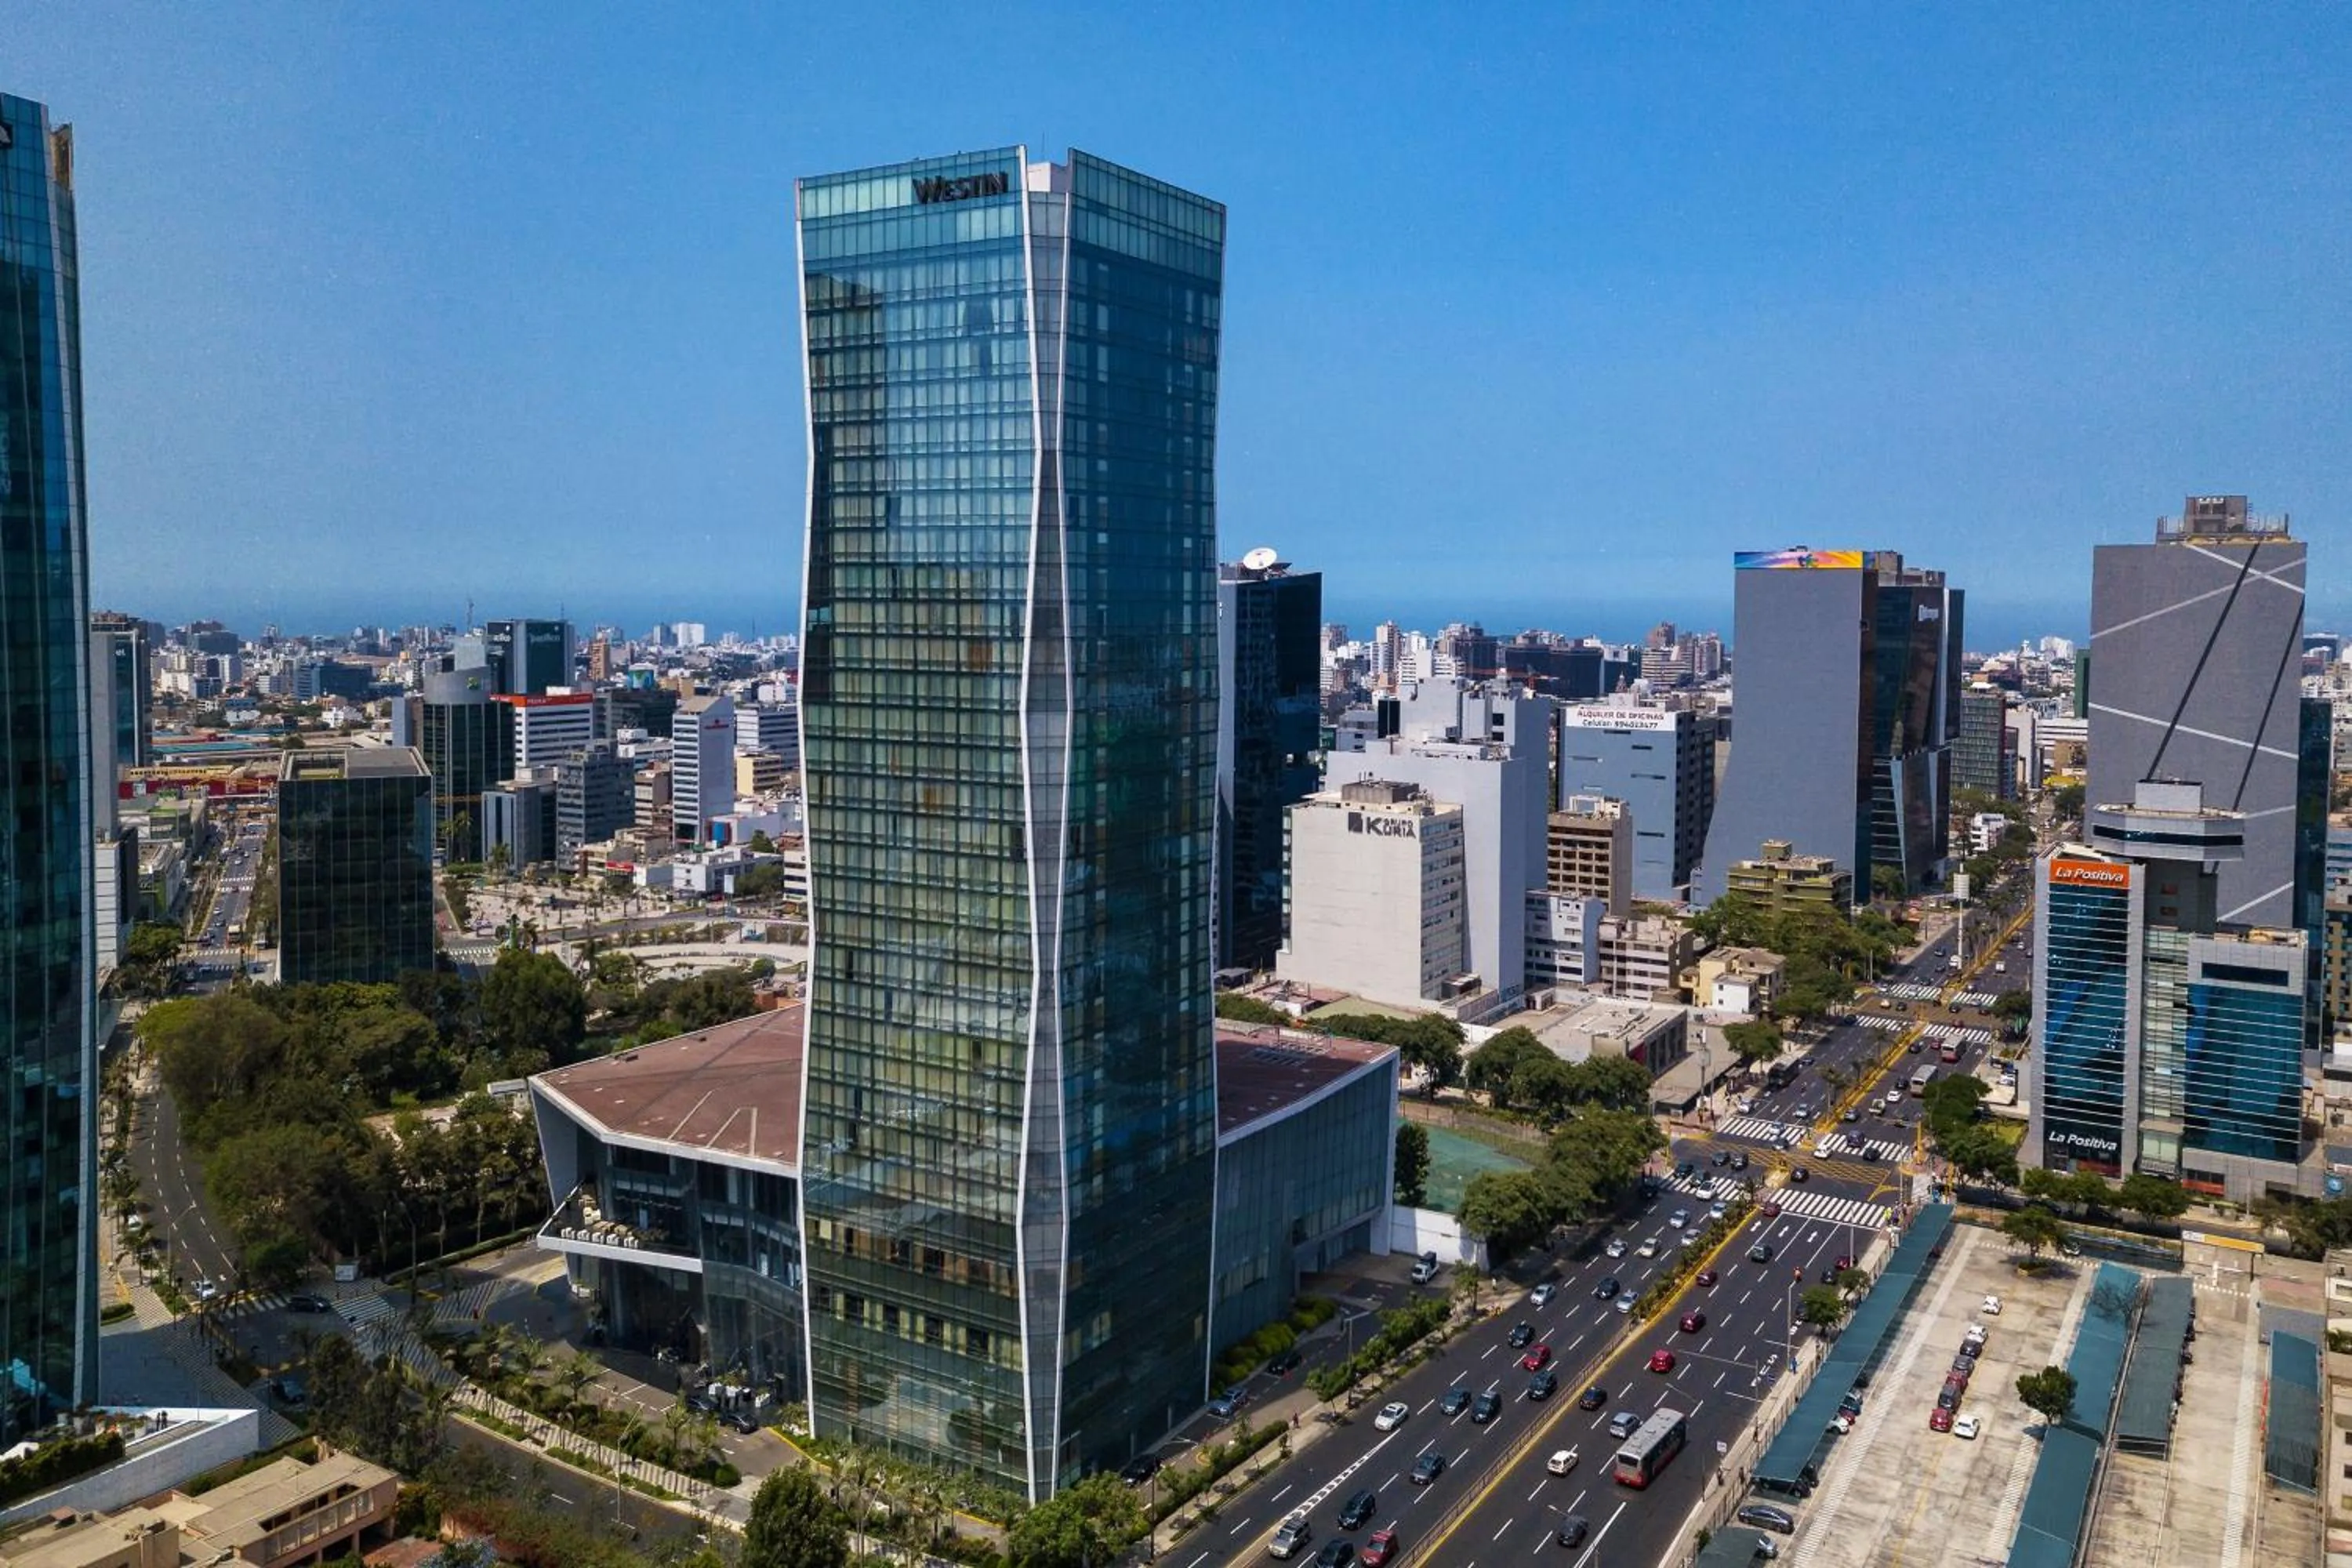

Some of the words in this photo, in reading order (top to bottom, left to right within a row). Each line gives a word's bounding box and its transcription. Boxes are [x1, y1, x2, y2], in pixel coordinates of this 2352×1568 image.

[912, 171, 1009, 204] WESTIN
[2056, 866, 2072, 878] La
[2074, 868, 2124, 882] Positiva
[2049, 1131, 2066, 1142] La
[2067, 1134, 2118, 1151] Positiva
